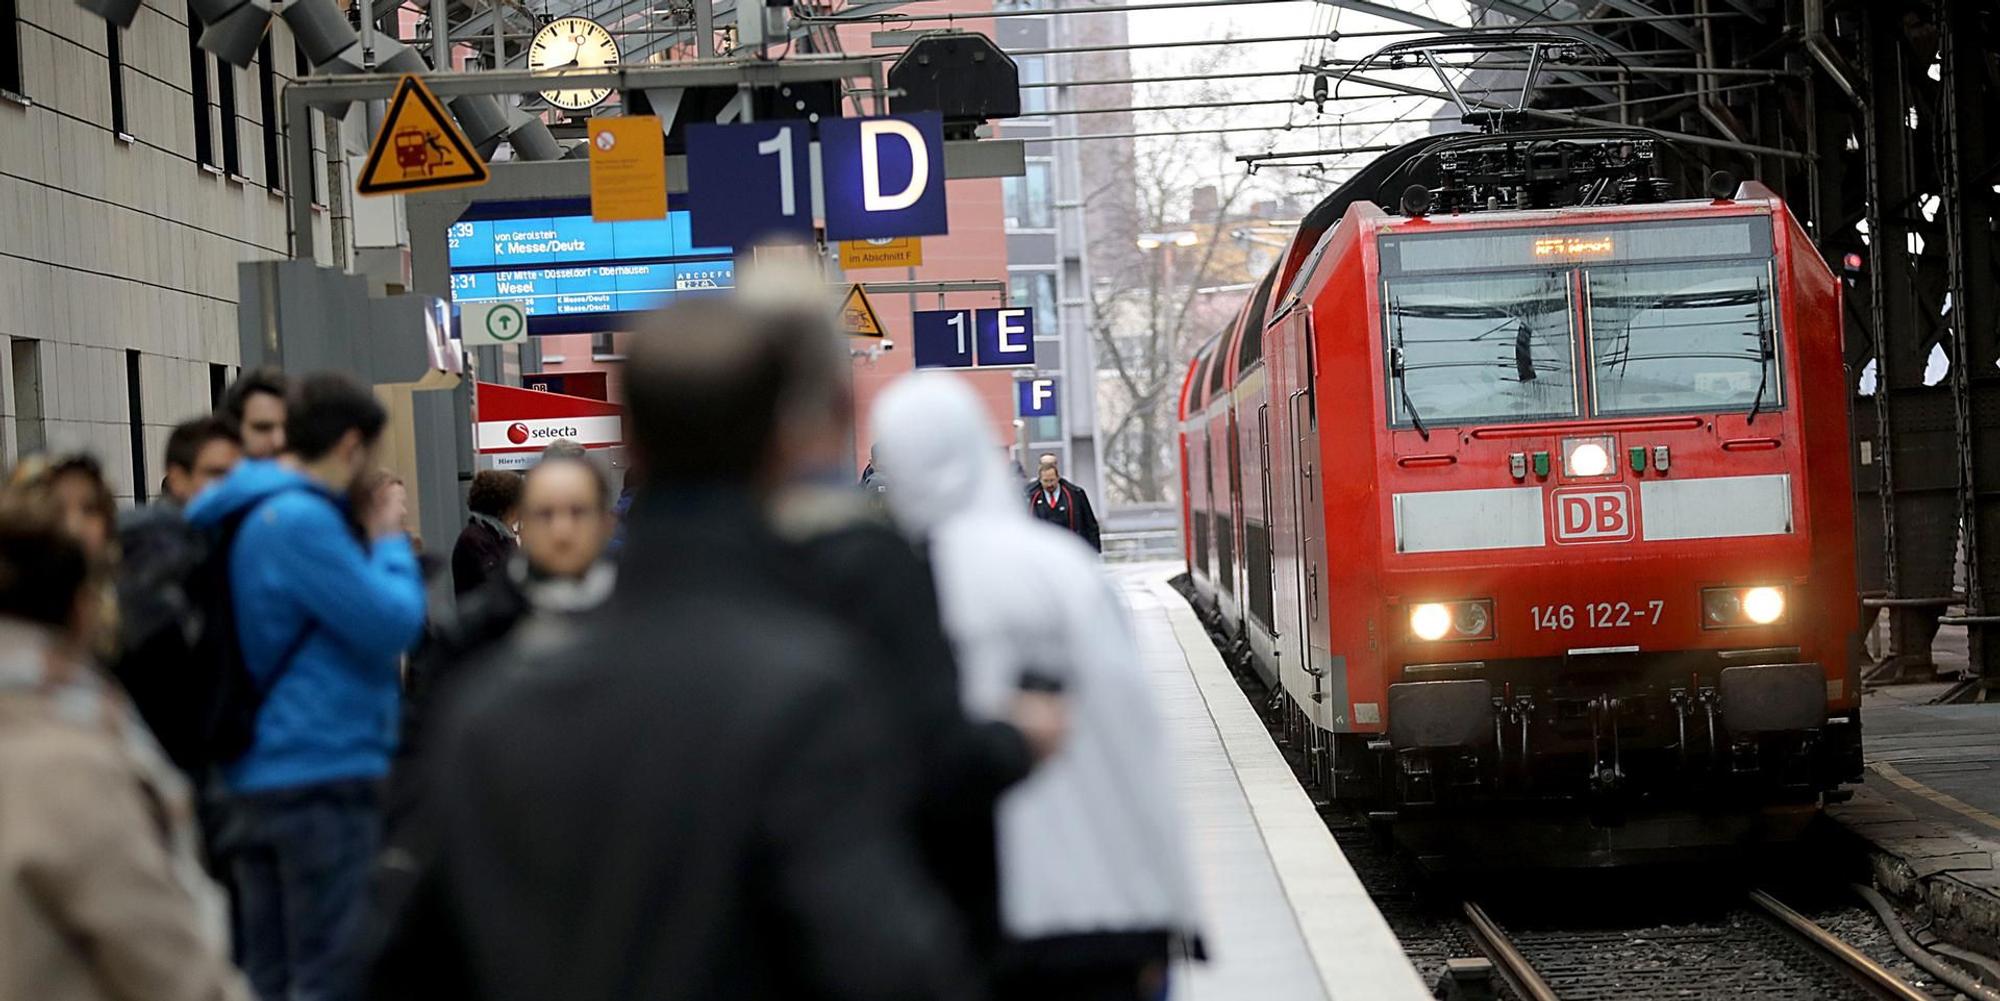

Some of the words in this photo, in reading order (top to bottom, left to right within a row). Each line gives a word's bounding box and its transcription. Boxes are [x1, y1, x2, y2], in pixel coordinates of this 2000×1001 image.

[758, 126, 795, 216] 1
[860, 119, 929, 212] D
[495, 233, 511, 241] von
[512, 230, 557, 241] Gerolstein
[495, 242, 504, 255] K
[508, 239, 586, 254] Messe/Deutz
[497, 271, 512, 281] LEV
[497, 282, 534, 294] Wesel
[947, 312, 965, 354] 1
[998, 309, 1027, 352] E
[1032, 379, 1052, 410] F
[532, 426, 577, 438] selecta
[1562, 495, 1624, 535] DB
[1531, 605, 1574, 630] 146
[1586, 600, 1664, 628] 122-7
